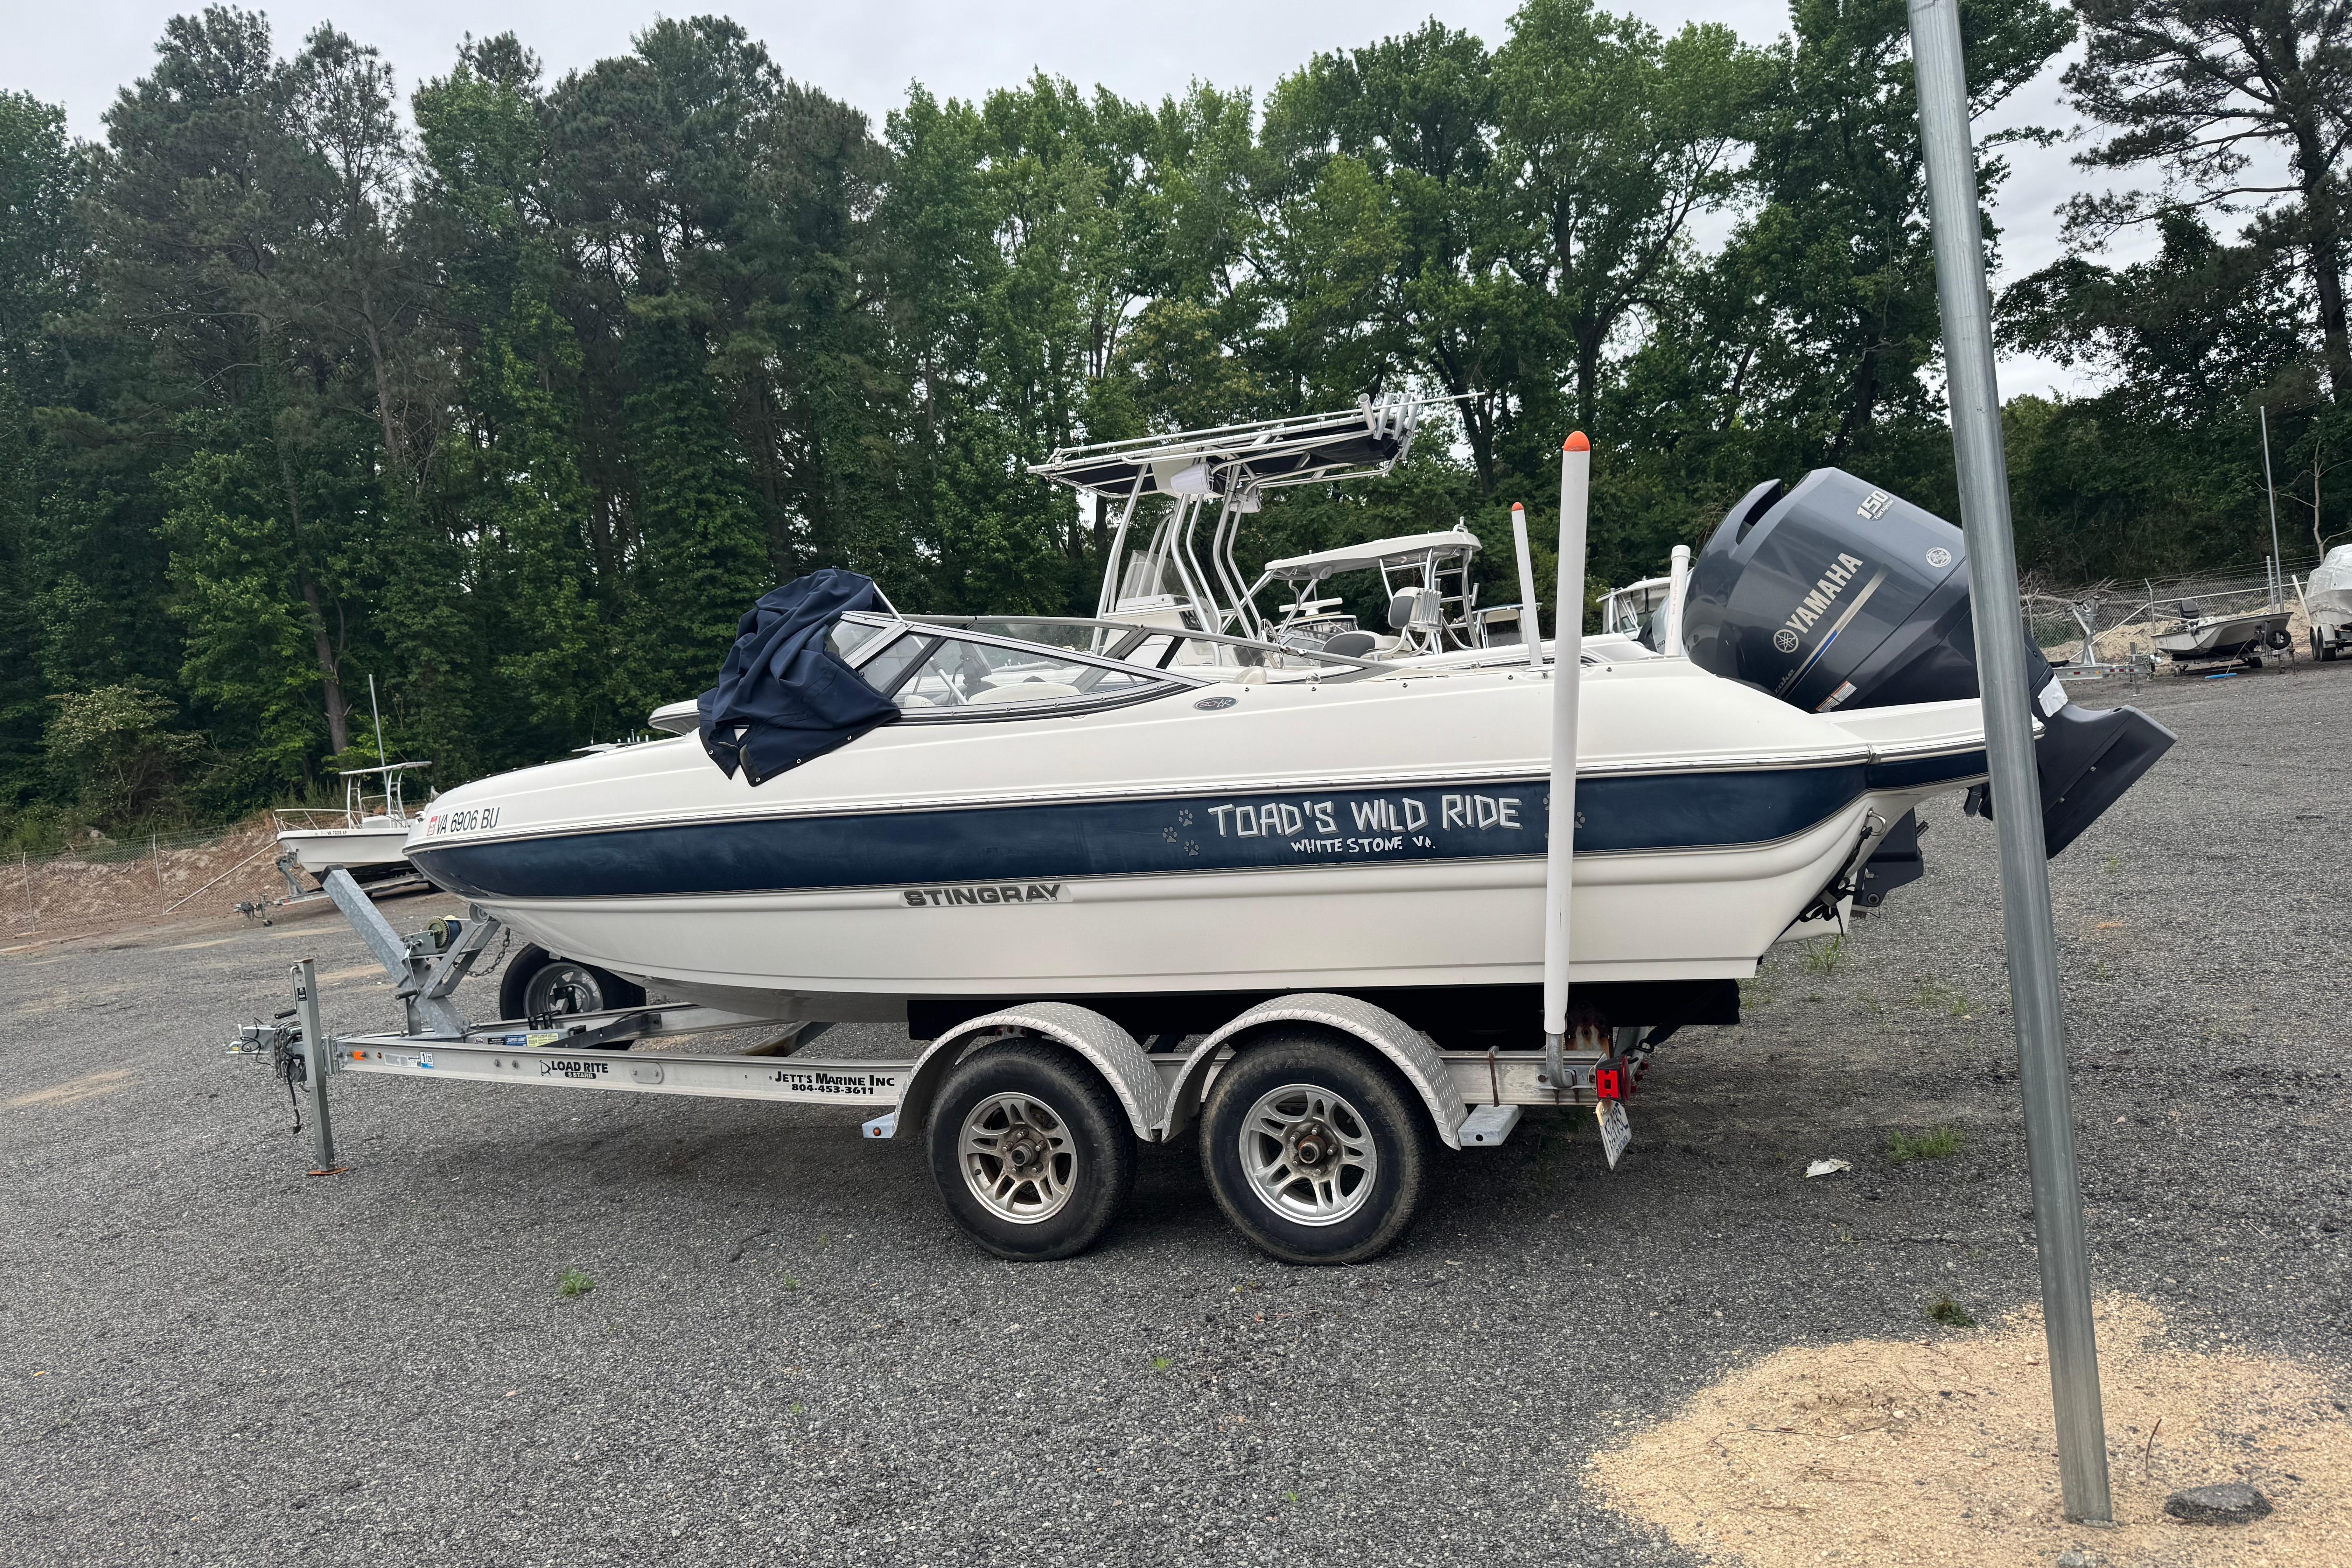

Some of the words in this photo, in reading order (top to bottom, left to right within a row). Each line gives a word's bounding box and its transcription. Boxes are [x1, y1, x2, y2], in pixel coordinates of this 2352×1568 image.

[1857, 490, 1888, 520] 150
[1785, 553, 1863, 634] YAMAHA
[437, 814, 448, 835] VA
[451, 810, 478, 833] 6906
[481, 807, 500, 829] BU
[1208, 800, 1339, 838] TOAD'S
[1351, 798, 1429, 833] WILD
[1442, 794, 1523, 831] RIDE
[1290, 838, 1343, 853] WHITE
[1347, 836, 1402, 853] STONE
[904, 884, 1061, 906] STINGRAY
[551, 1061, 581, 1071] LOAD
[583, 1062, 609, 1073] RITE
[775, 1071, 812, 1083] JETT'S
[816, 1073, 865, 1086] MARINE
[869, 1075, 895, 1086] INC
[792, 1084, 873, 1094] 804-453-3611
